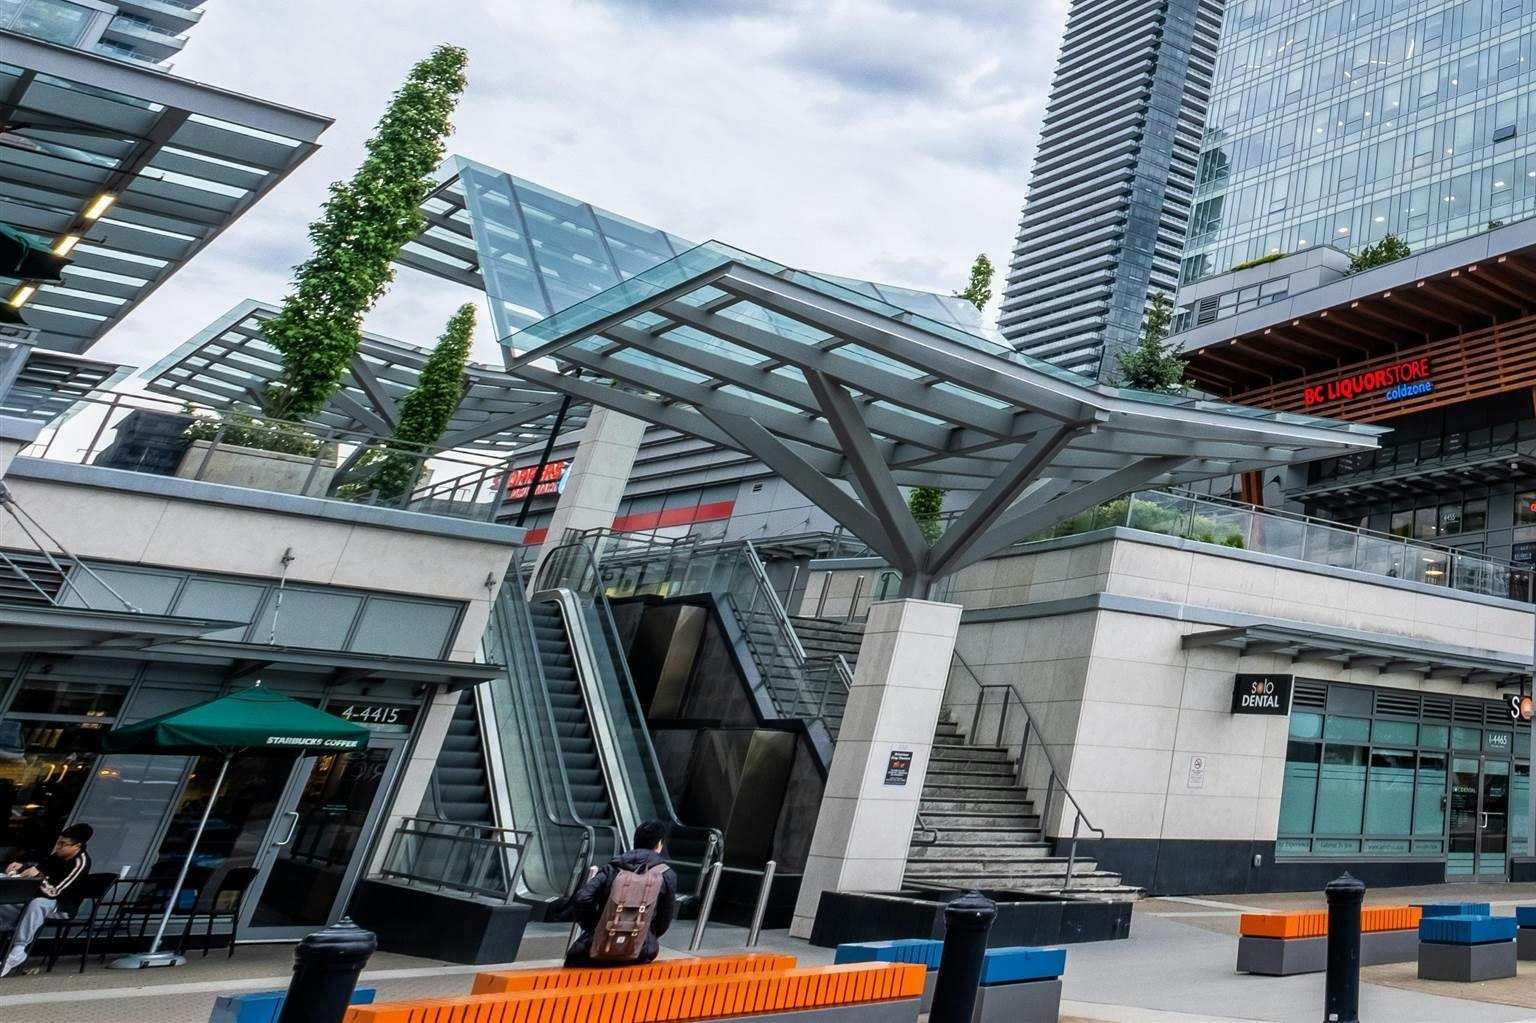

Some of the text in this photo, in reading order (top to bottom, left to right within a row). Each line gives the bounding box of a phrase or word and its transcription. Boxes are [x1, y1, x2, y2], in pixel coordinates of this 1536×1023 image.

[1304, 385, 1324, 406] BC
[1386, 381, 1432, 401] coldzone
[1241, 694, 1280, 708] DENTAL
[341, 704, 401, 724] 4-4415
[266, 735, 359, 748] STARBUCKS COFFEE
